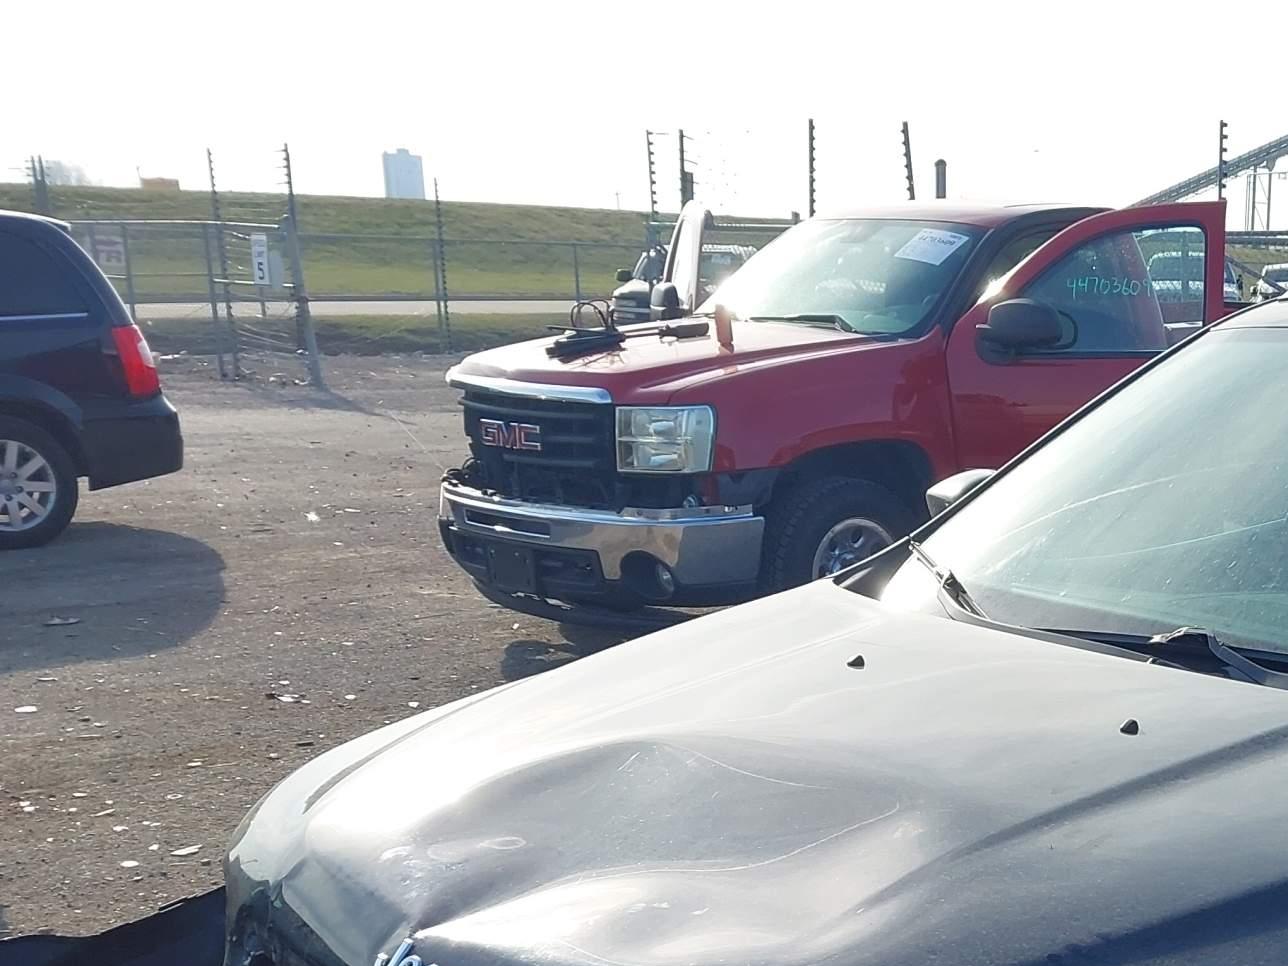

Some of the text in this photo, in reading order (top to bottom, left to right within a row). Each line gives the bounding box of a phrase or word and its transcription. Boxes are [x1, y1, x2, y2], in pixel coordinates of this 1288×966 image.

[257, 262, 265, 280] 5
[1067, 276, 1152, 300] 44703609
[480, 418, 541, 450] GMC
